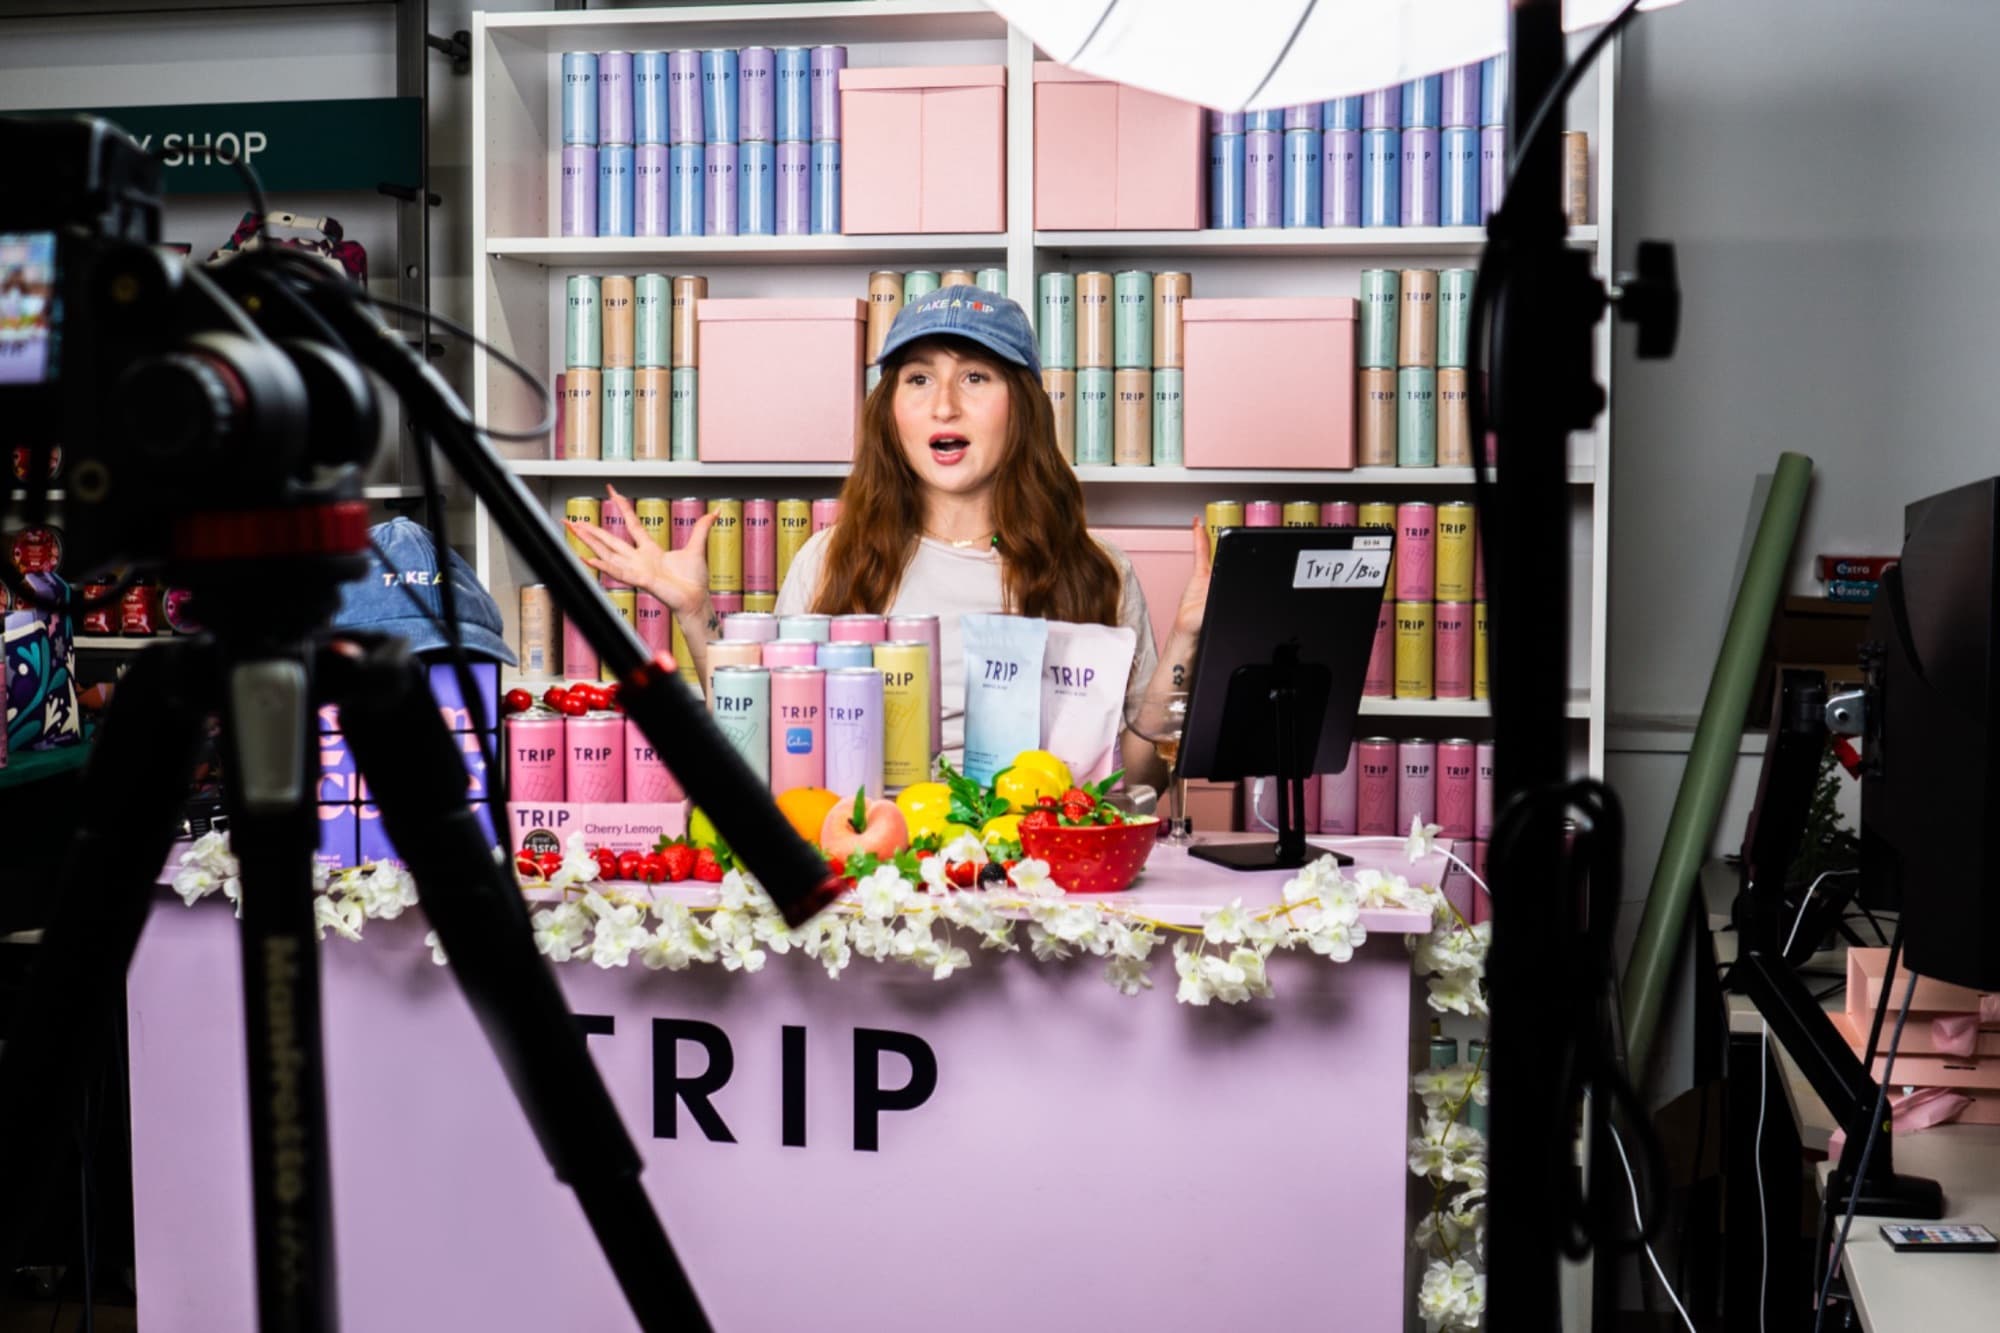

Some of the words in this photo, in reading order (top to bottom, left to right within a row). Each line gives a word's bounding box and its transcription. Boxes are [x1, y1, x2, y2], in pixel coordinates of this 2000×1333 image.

[743, 69, 767, 78] TRIP
[163, 131, 267, 167] SHOP
[1249, 153, 1274, 163] TRP
[1406, 151, 1431, 161] TRP
[570, 297, 593, 306] TRIP
[871, 294, 895, 303] TRIP
[1406, 292, 1432, 301] TRIP
[605, 298, 628, 307] TRIP
[916, 298, 950, 313] TAKE
[568, 389, 592, 398] TRIP
[1082, 391, 1107, 400] TRIP
[1120, 391, 1145, 401] TRIP
[1156, 391, 1180, 400] TRIP
[1371, 391, 1395, 401] TRIP
[1407, 391, 1433, 401] TRIP
[1442, 391, 1468, 401] TRIP
[640, 516, 665, 527] TRIP
[673, 517, 697, 527] TRIP
[746, 517, 769, 528] TRIP
[781, 517, 808, 528] TRIP
[1405, 527, 1431, 537] TRIP
[1440, 523, 1467, 534] TRIP
[382, 570, 430, 587] TAKE
[638, 609, 662, 619] TRIP
[1397, 620, 1425, 631] TRIP
[1437, 620, 1462, 630] TRIP
[985, 660, 1018, 682] TRIP
[1050, 665, 1095, 688] TRIP
[885, 671, 914, 687] RIP
[716, 695, 753, 712] TRIP
[782, 706, 818, 719] TRIP
[829, 706, 864, 721] TRIP
[518, 747, 556, 763] TRIP
[574, 746, 612, 761] TRIP
[633, 747, 661, 761] TRI
[1363, 764, 1388, 776] TRIP
[1405, 764, 1430, 776] TRIP
[1446, 765, 1470, 777] TRIP
[516, 809, 570, 827] TRIP
[585, 823, 622, 836] Cherry
[625, 823, 663, 834] Lemon
